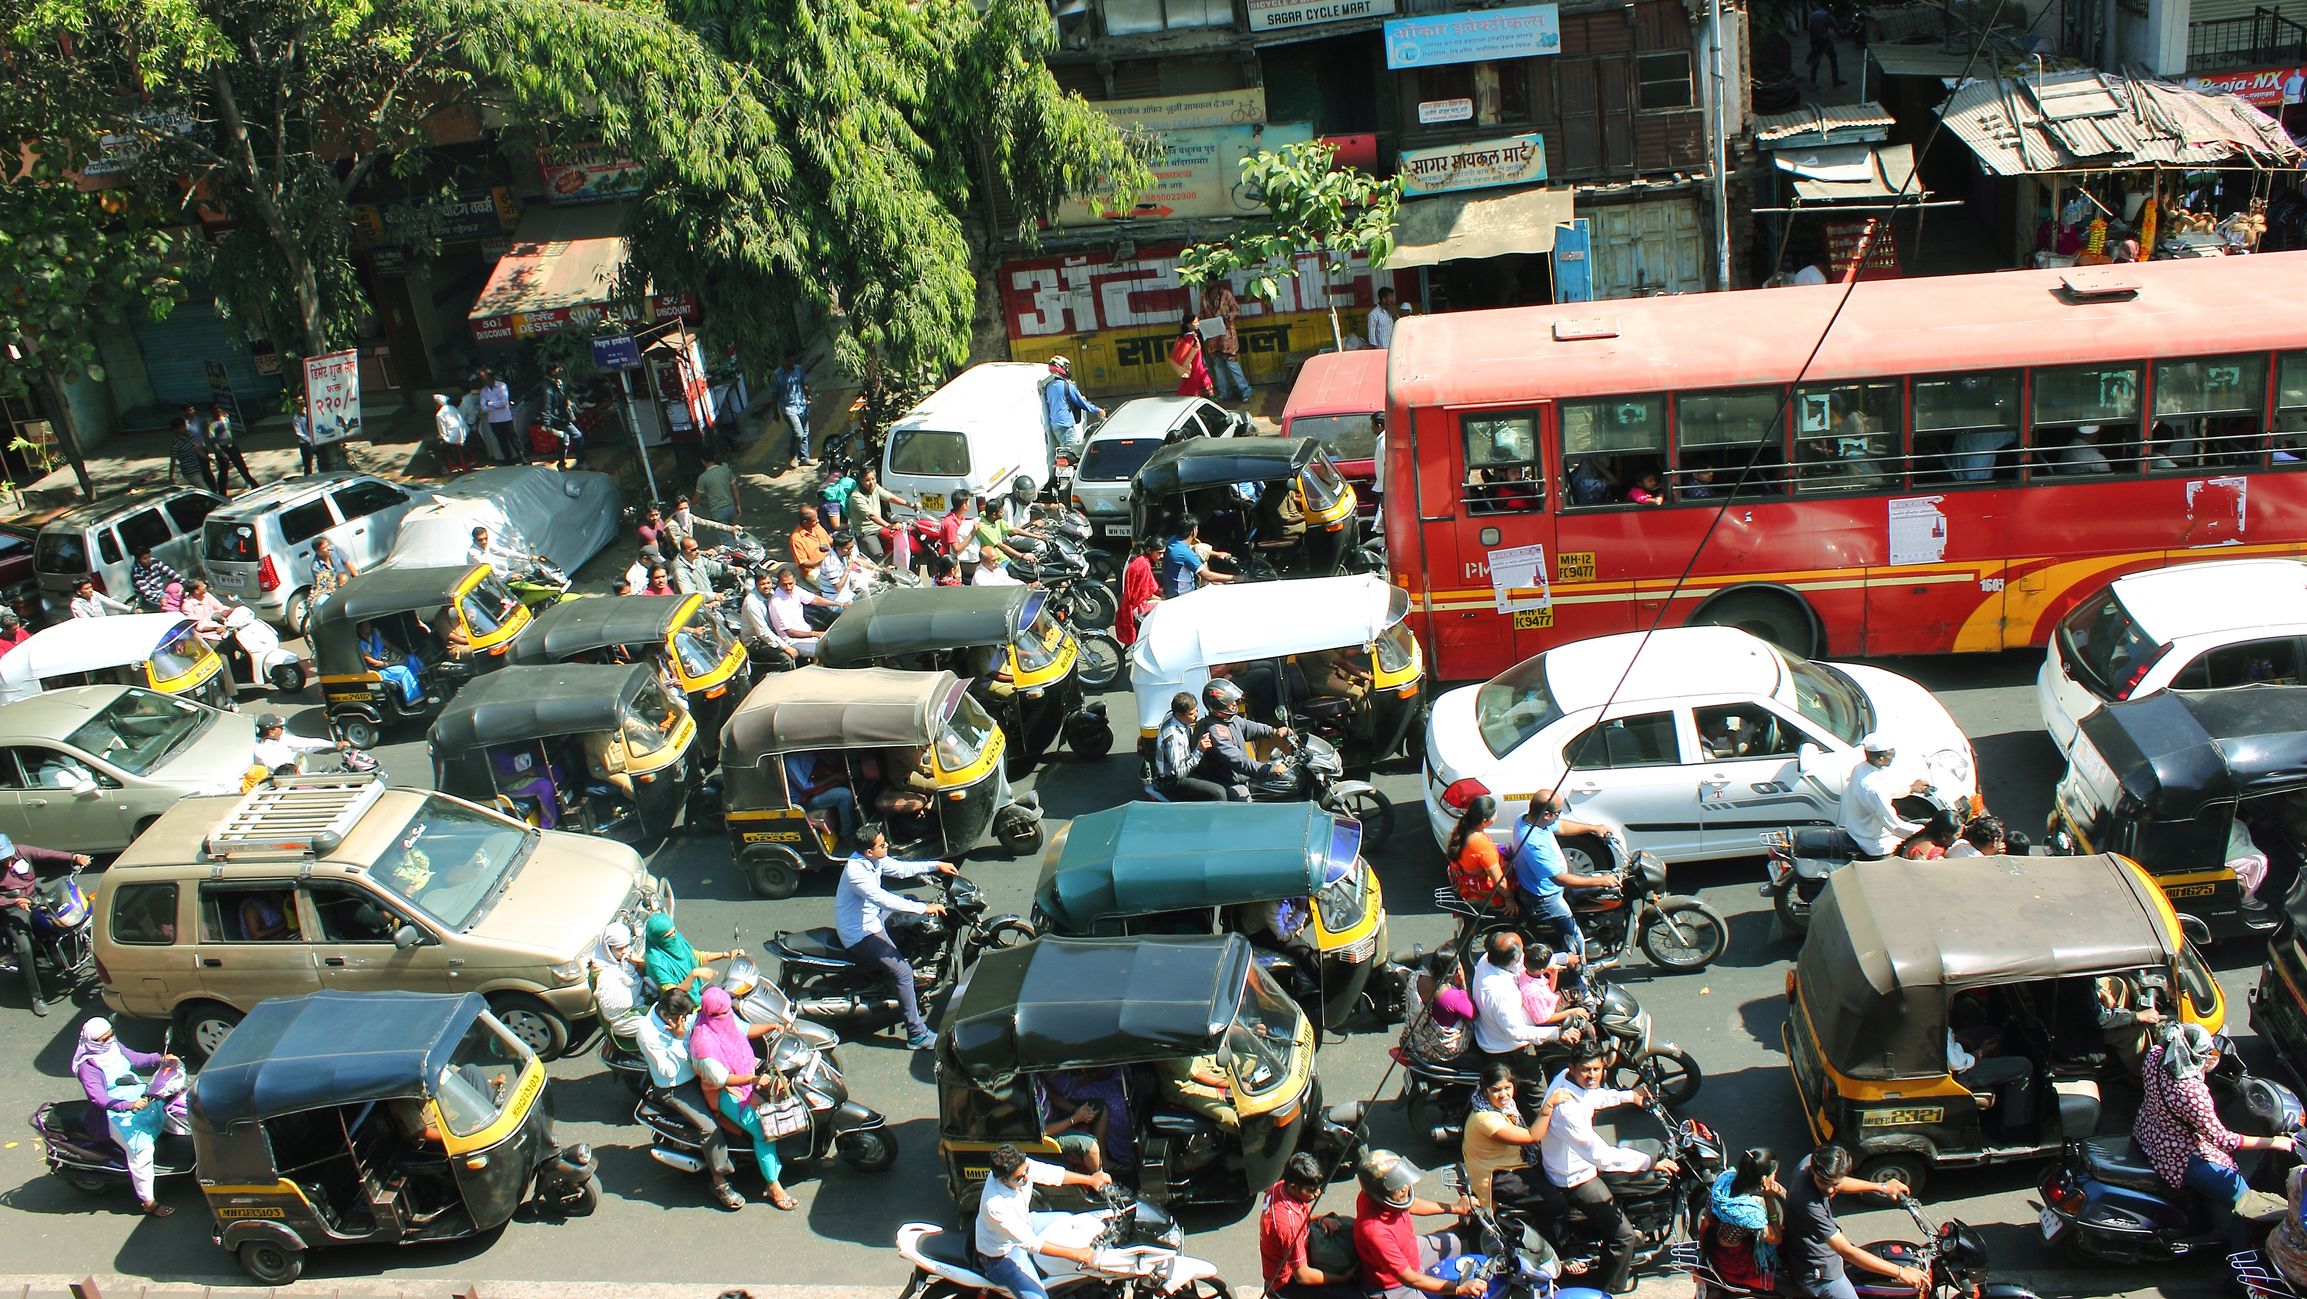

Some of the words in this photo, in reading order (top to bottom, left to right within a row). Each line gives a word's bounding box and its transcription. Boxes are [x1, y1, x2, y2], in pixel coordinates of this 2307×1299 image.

[1267, 12, 1302, 25] SAGAR
[1306, 5, 1339, 20] CYCLE
[1342, 1, 1371, 15] MART
[1411, 156, 1448, 175] सागर
[1451, 150, 1499, 170] सायकल
[1502, 141, 1529, 163] मार्ट
[656, 304, 692, 318] DISCOUNT
[476, 327, 512, 341] DISCOUNT
[1560, 555, 1592, 565] MH-12
[1559, 566, 1594, 578] FC9477
[1516, 616, 1551, 628] FC9477
